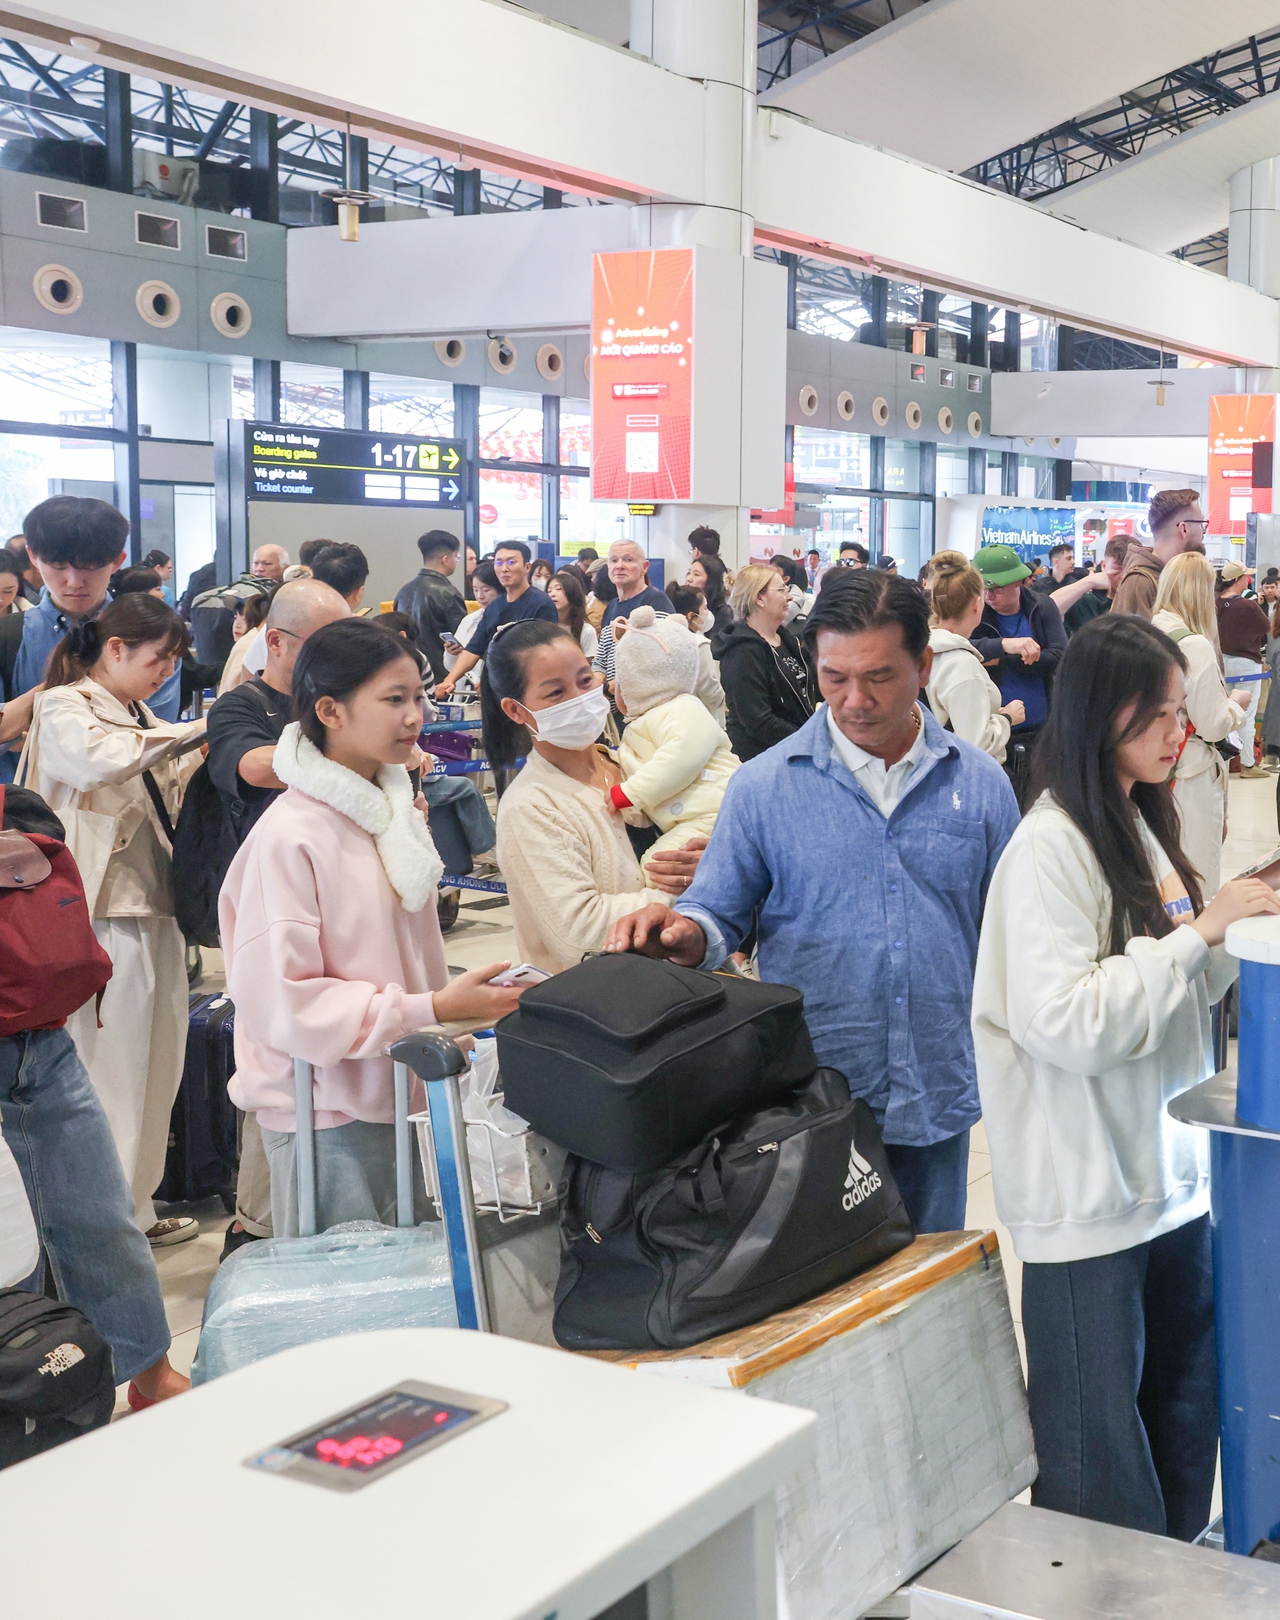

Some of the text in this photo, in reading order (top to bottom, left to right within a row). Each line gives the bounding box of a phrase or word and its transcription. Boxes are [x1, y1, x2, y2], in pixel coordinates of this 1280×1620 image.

[616, 327, 669, 338] Advertising
[253, 430, 274, 442] Cửa
[275, 433, 285, 443] ra
[302, 434, 320, 448] bay
[253, 445, 317, 460] Boarding gates
[371, 442, 417, 468] 1-17
[254, 482, 314, 495] Ticket counter
[983, 527, 1051, 546] Vietnam Airlines
[842, 1171, 882, 1211] adidas
[44, 1347, 64, 1362] THE
[38, 1355, 67, 1375] NORTH
[51, 1359, 73, 1377] FACE
